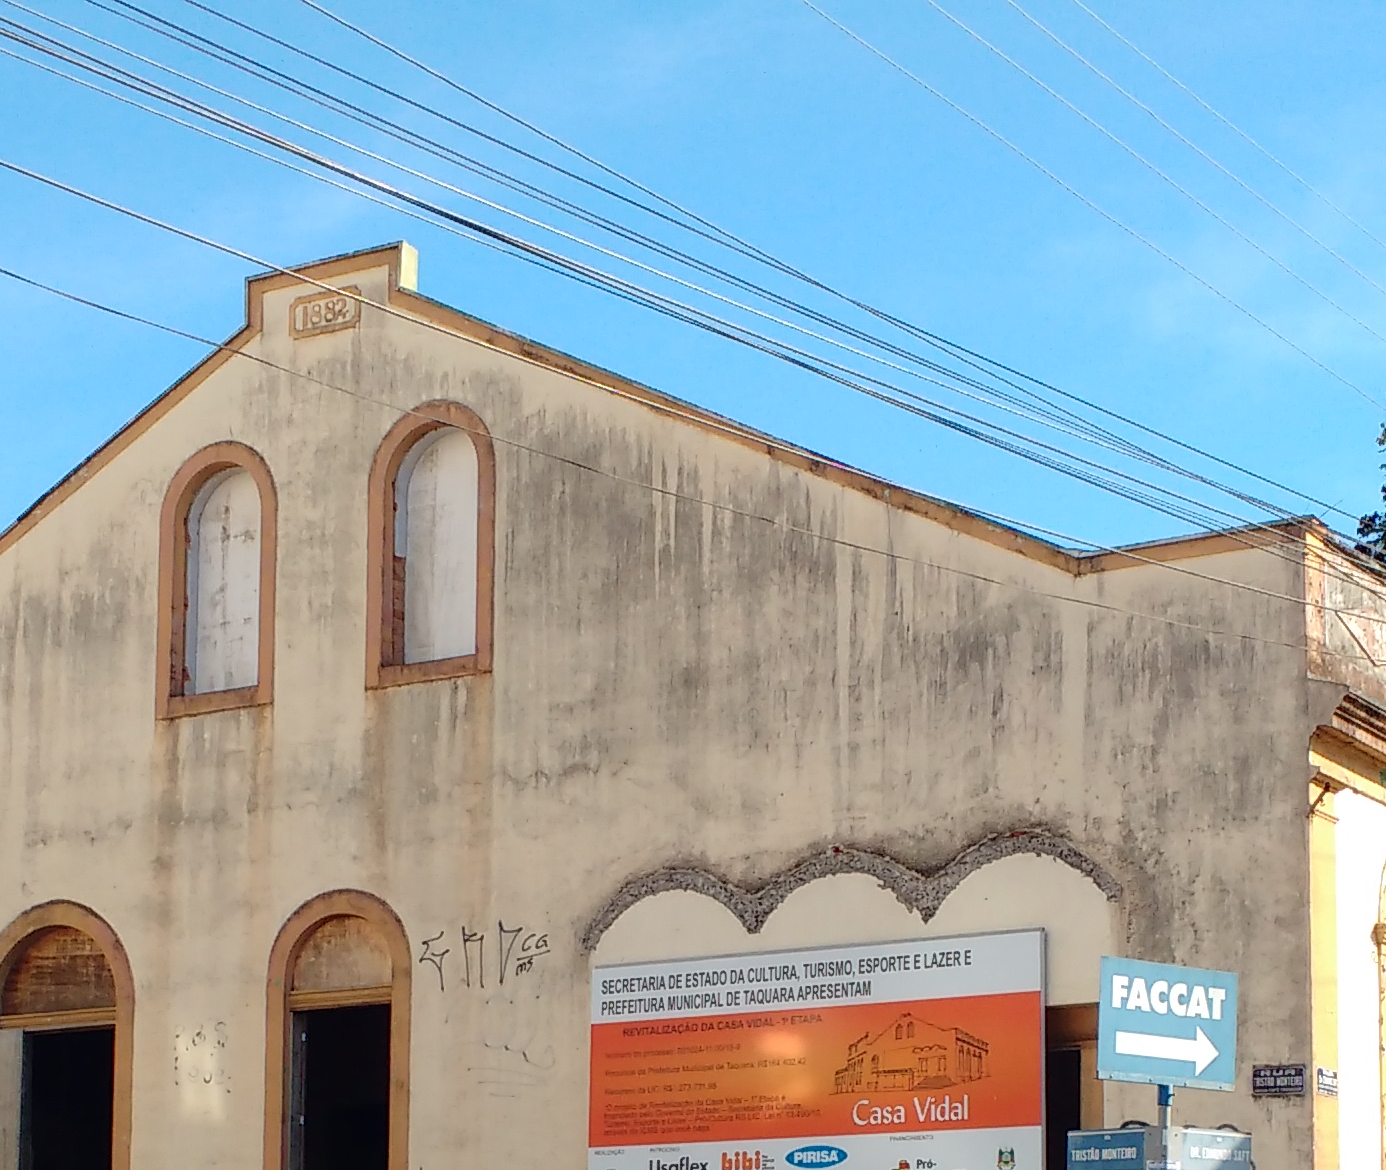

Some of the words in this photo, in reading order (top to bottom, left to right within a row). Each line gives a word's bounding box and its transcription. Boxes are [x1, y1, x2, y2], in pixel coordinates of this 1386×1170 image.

[601, 976, 666, 995] SECRETARIA
[669, 974, 683, 989] DE
[686, 970, 728, 988] ESTADO
[730, 969, 745, 985] DA
[748, 964, 800, 983] CULTURA,
[803, 960, 856, 979] TURISMO,
[858, 955, 910, 975] ESPORTE
[914, 954, 921, 970] E
[924, 951, 961, 969] LAZER
[965, 950, 972, 965] E
[601, 997, 665, 1016] PREFEITURA
[667, 992, 723, 1011] MUNICIPAL
[726, 991, 741, 1006] DE
[743, 987, 795, 1006] TAQUARA
[797, 980, 872, 1001] APRESENTAM
[1111, 974, 1226, 1020] FACCAT
[623, 1021, 698, 1037] REVITALIZAÇÃO
[701, 1022, 715, 1032] DA
[717, 1020, 744, 1031] CASA
[746, 1017, 774, 1028] VIDAL
[791, 1013, 823, 1025] ETAPA
[1260, 1068, 1296, 1077] RUA
[852, 1099, 906, 1126] Casa
[913, 1094, 969, 1123] Vidal
[721, 1150, 761, 1170] bibi
[793, 1149, 839, 1164] PIRISA
[916, 1158, 937, 1170] Pró-
[1071, 1147, 1100, 1161] TRISTÃO
[1101, 1146, 1137, 1160] MONTEIRO
